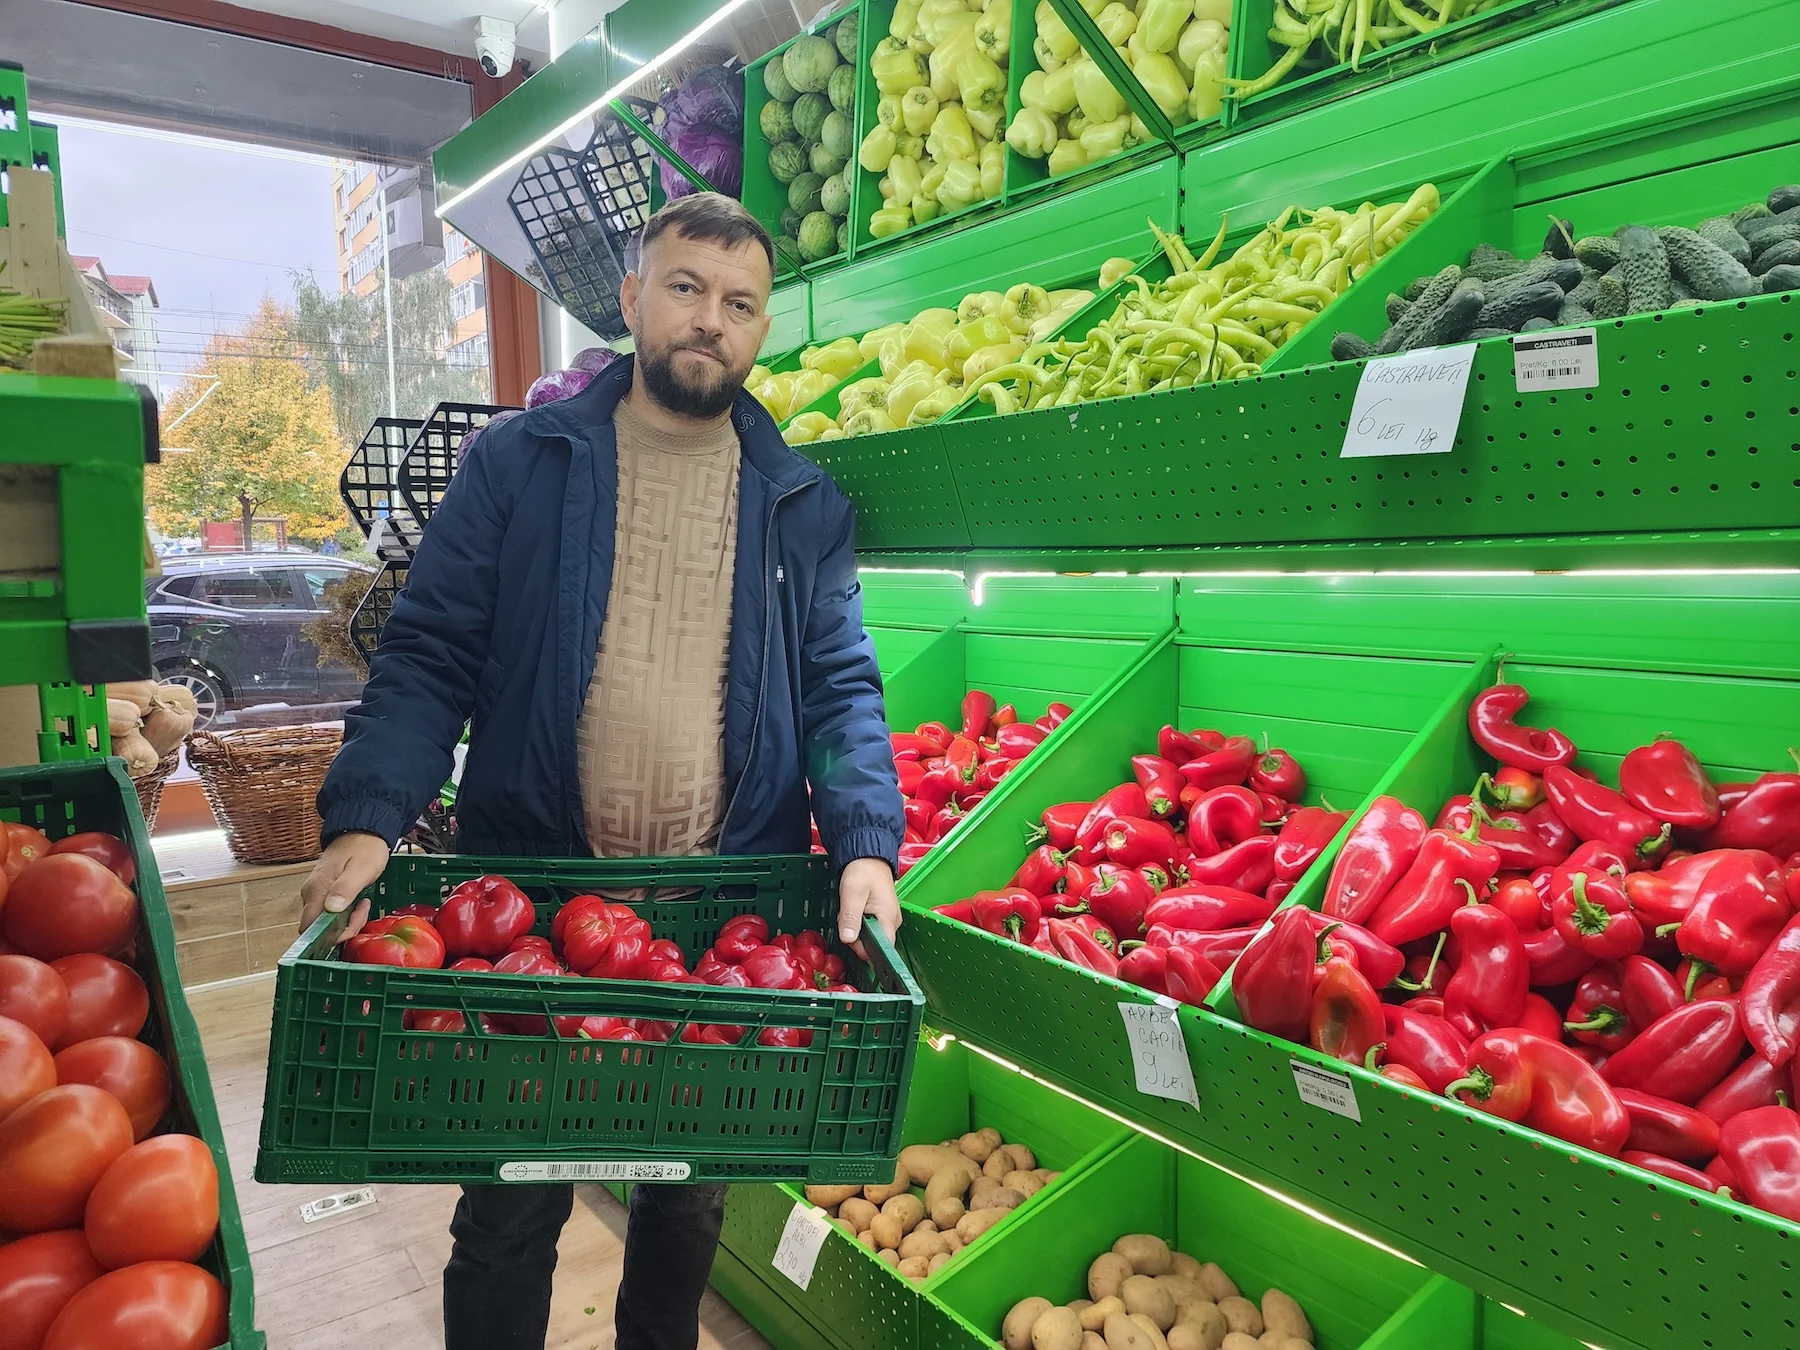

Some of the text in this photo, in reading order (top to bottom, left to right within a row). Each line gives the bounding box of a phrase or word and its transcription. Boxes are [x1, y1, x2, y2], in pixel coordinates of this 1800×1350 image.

[1533, 339, 1578, 349] CASTRAVETI
[1356, 397, 1392, 435] 6
[666, 1167, 686, 1177] 216
